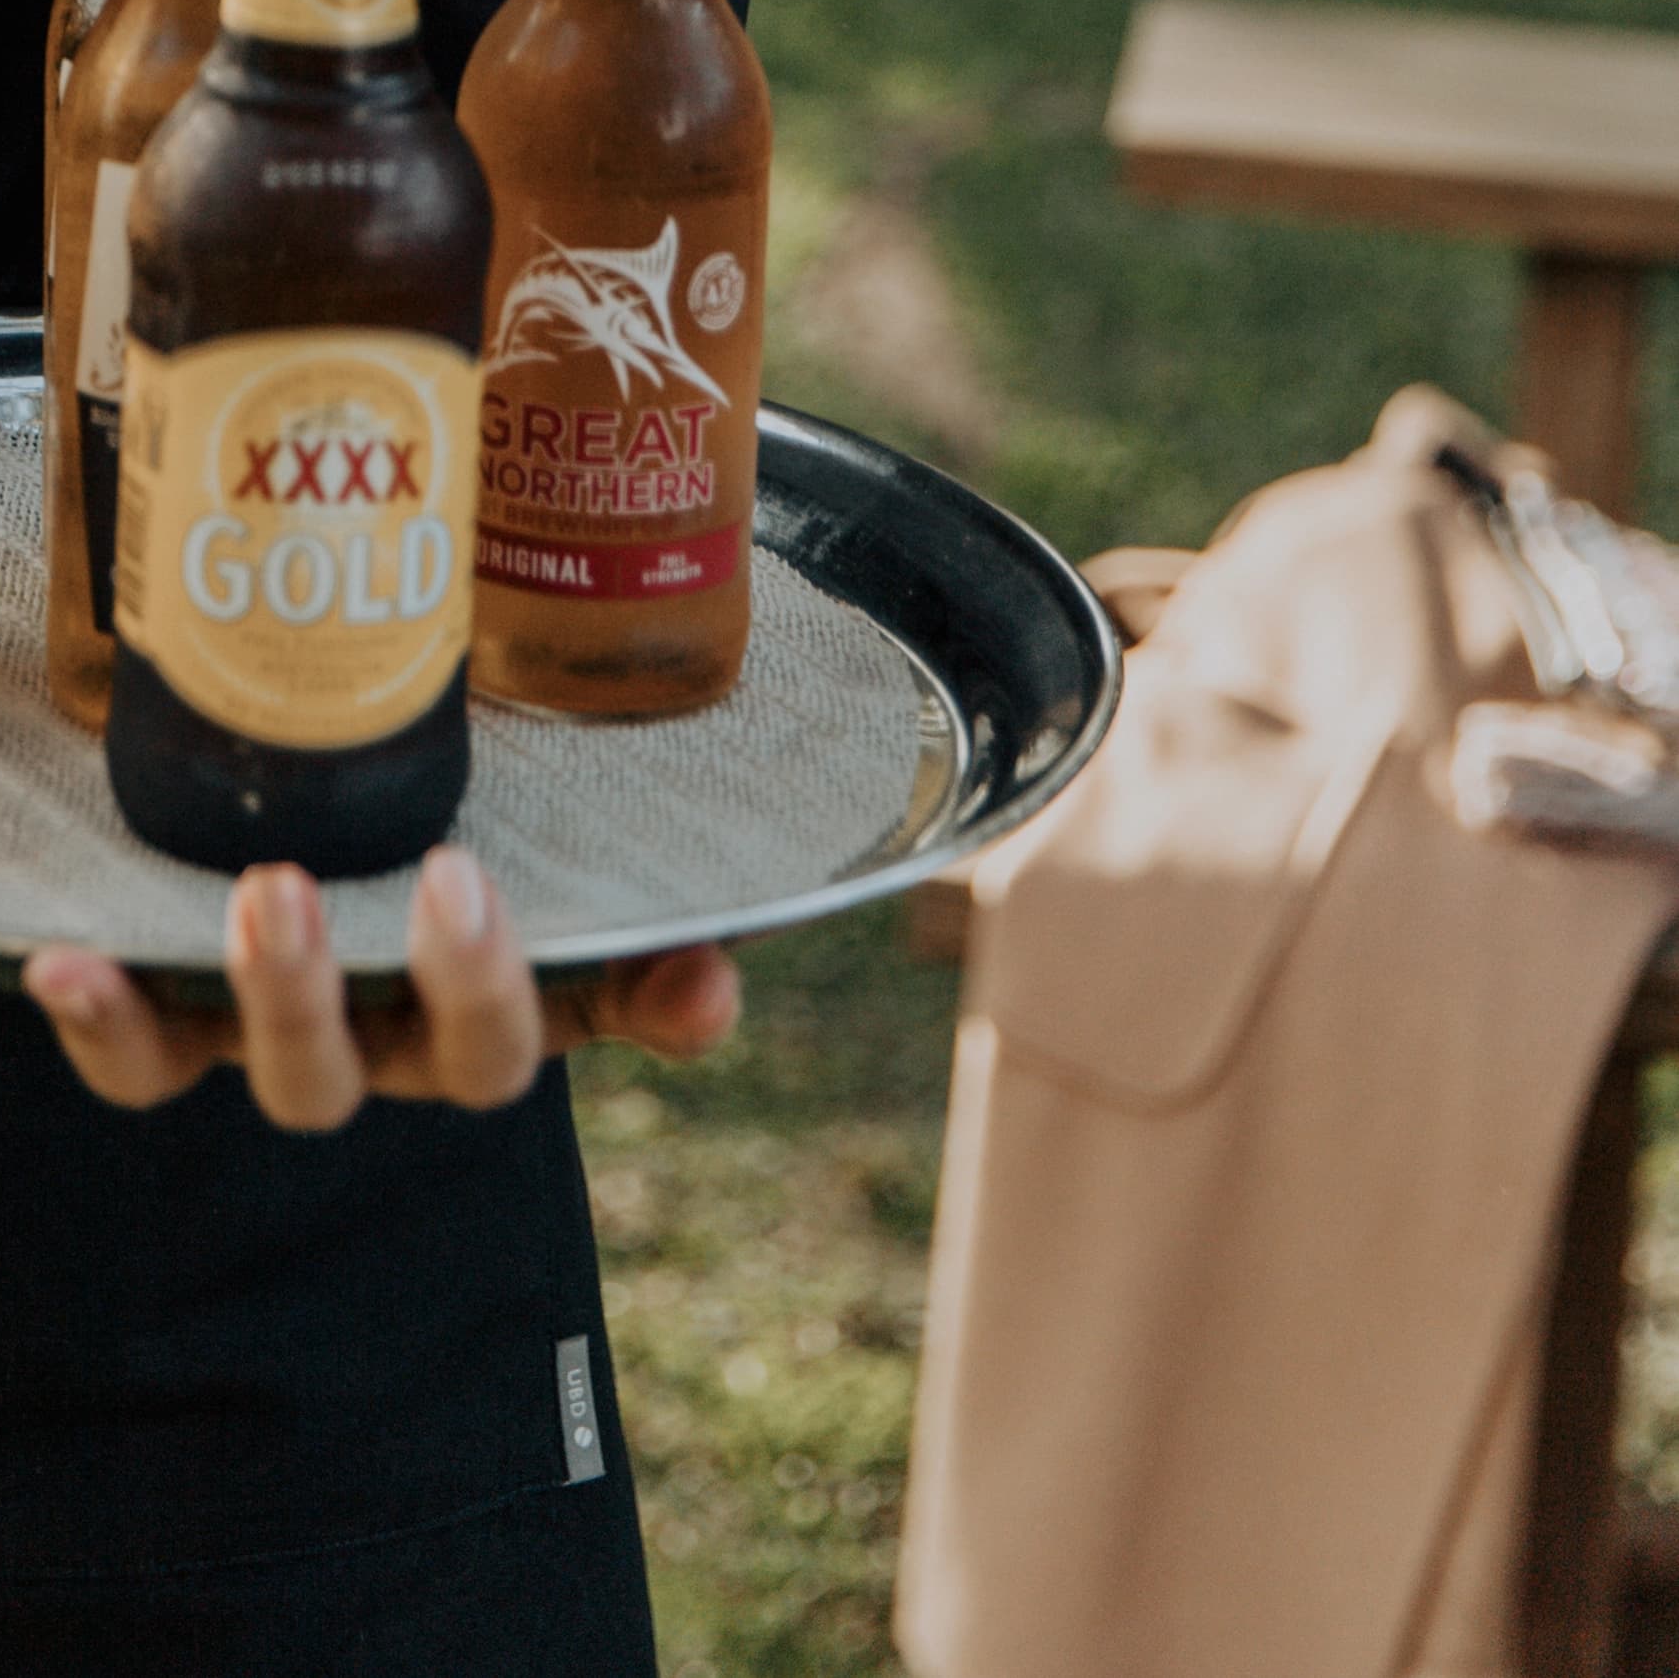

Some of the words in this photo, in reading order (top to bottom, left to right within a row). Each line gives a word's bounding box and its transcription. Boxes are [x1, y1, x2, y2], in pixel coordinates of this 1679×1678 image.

[481, 393, 718, 472] GREAT
[234, 438, 421, 504] XXXX
[182, 513, 454, 626] GOLD
[566, 1368, 587, 1418] UBD
